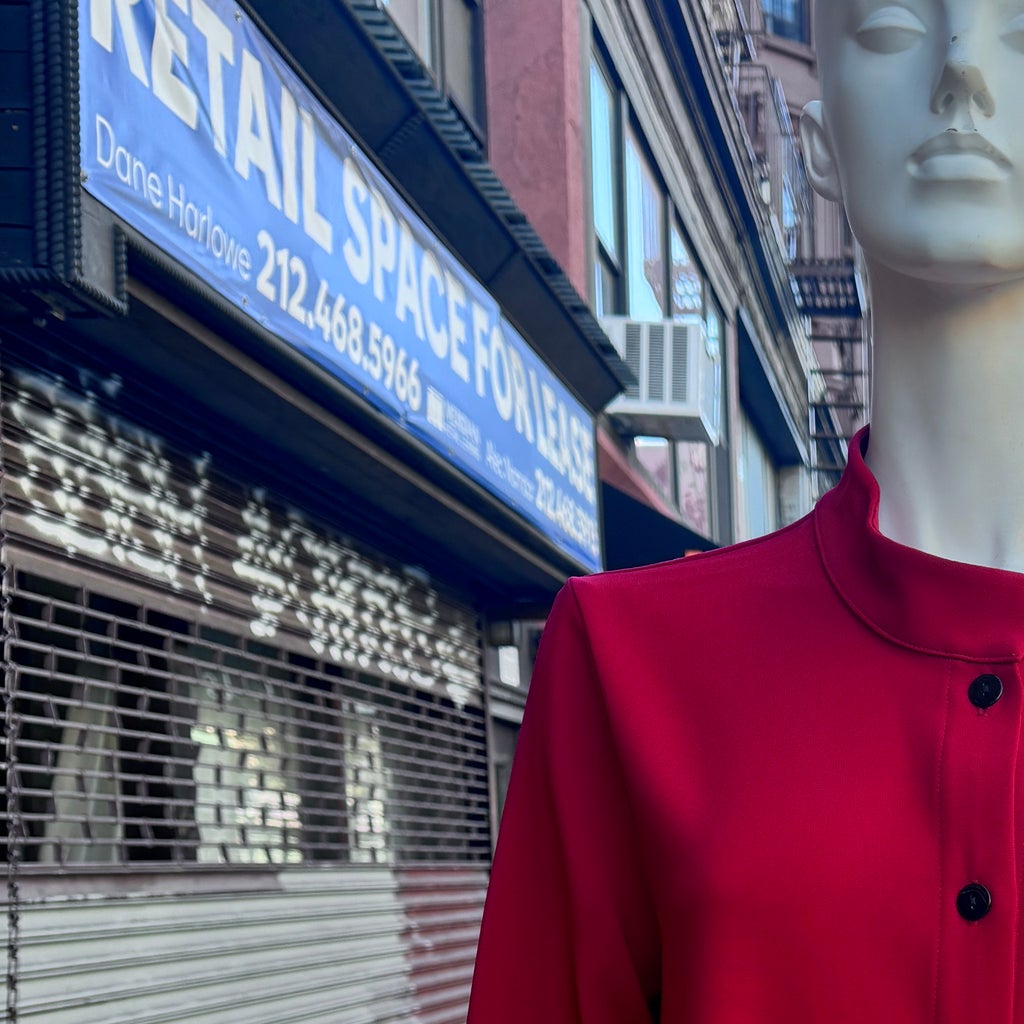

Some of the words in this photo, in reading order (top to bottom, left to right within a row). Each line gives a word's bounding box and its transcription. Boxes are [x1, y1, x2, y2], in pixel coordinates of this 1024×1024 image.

[96, 113, 163, 210] Dane
[168, 174, 250, 281] Harlowe
[256, 230, 422, 412] 212.468.5966
[343, 157, 470, 384] SPACE
[471, 302, 535, 444] FOR
[528, 366, 595, 505] LEASE
